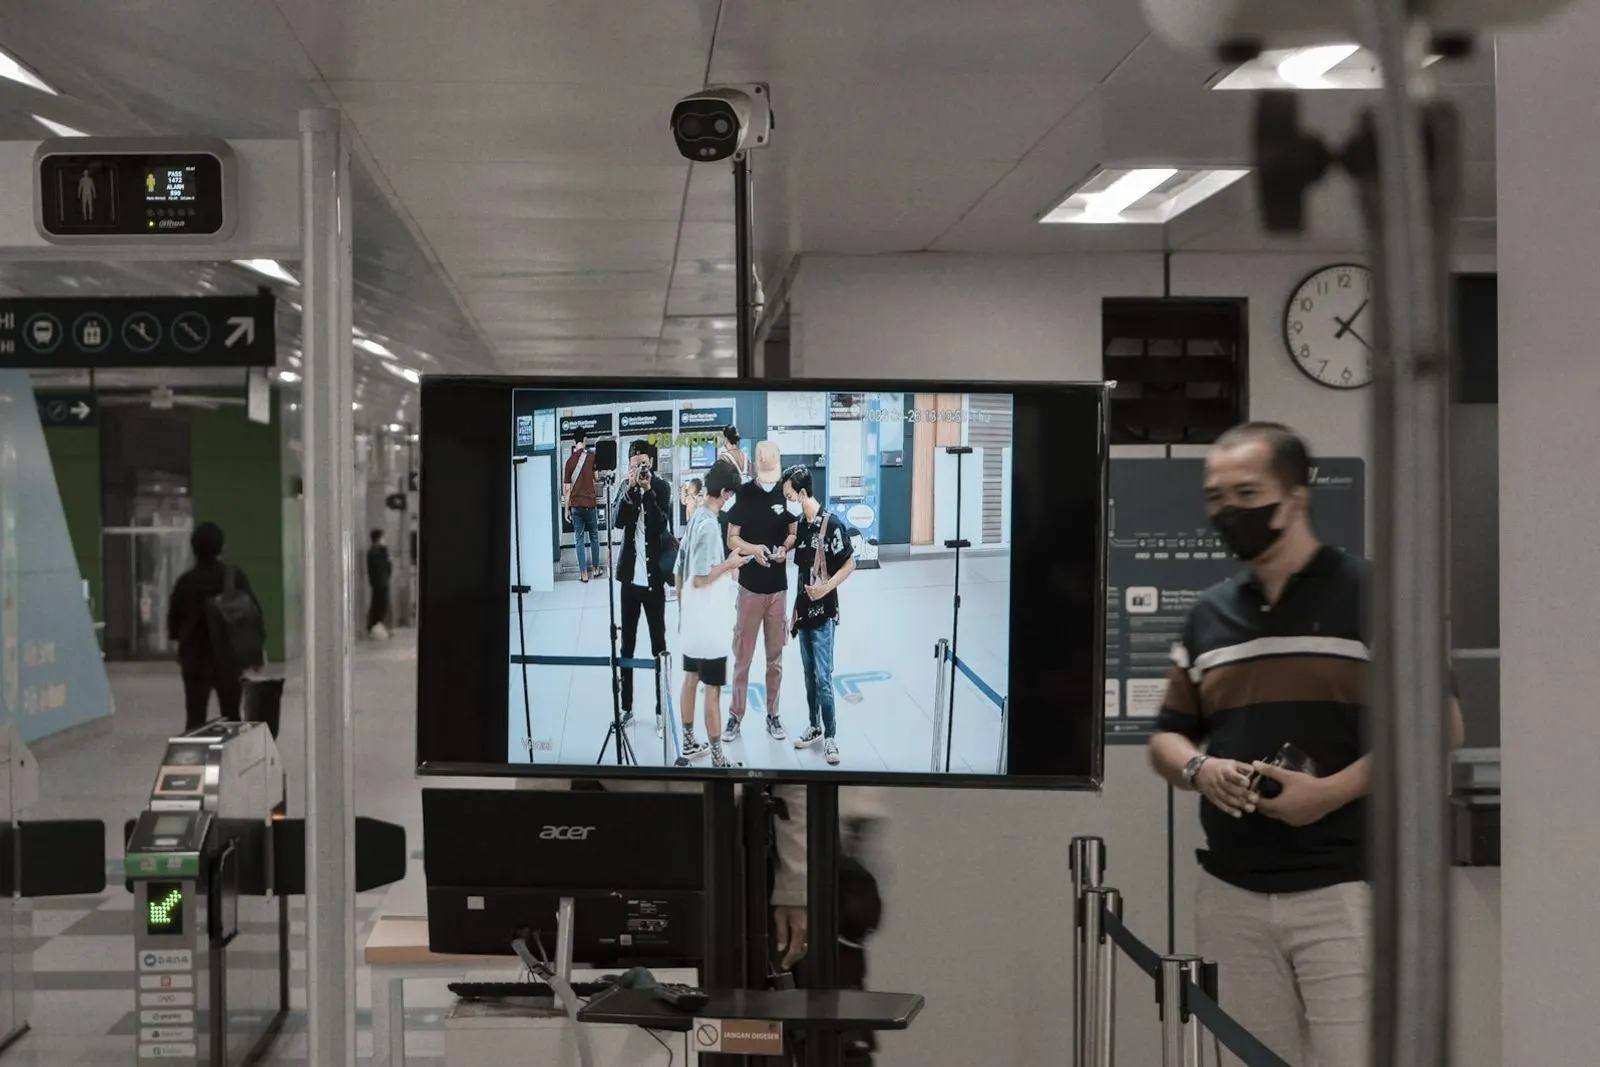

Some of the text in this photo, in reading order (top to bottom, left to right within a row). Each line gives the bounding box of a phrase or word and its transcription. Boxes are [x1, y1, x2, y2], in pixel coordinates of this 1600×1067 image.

[1338, 274, 1350, 288] 12
[1318, 281, 1328, 296] 11
[1300, 298, 1313, 312] 10
[1293, 321, 1303, 334] 9
[1301, 344, 1310, 358] 8
[1318, 360, 1329, 377] 7
[1341, 367, 1352, 381] 6
[539, 825, 596, 840] acer
[723, 1031, 751, 1040] JANGAN
